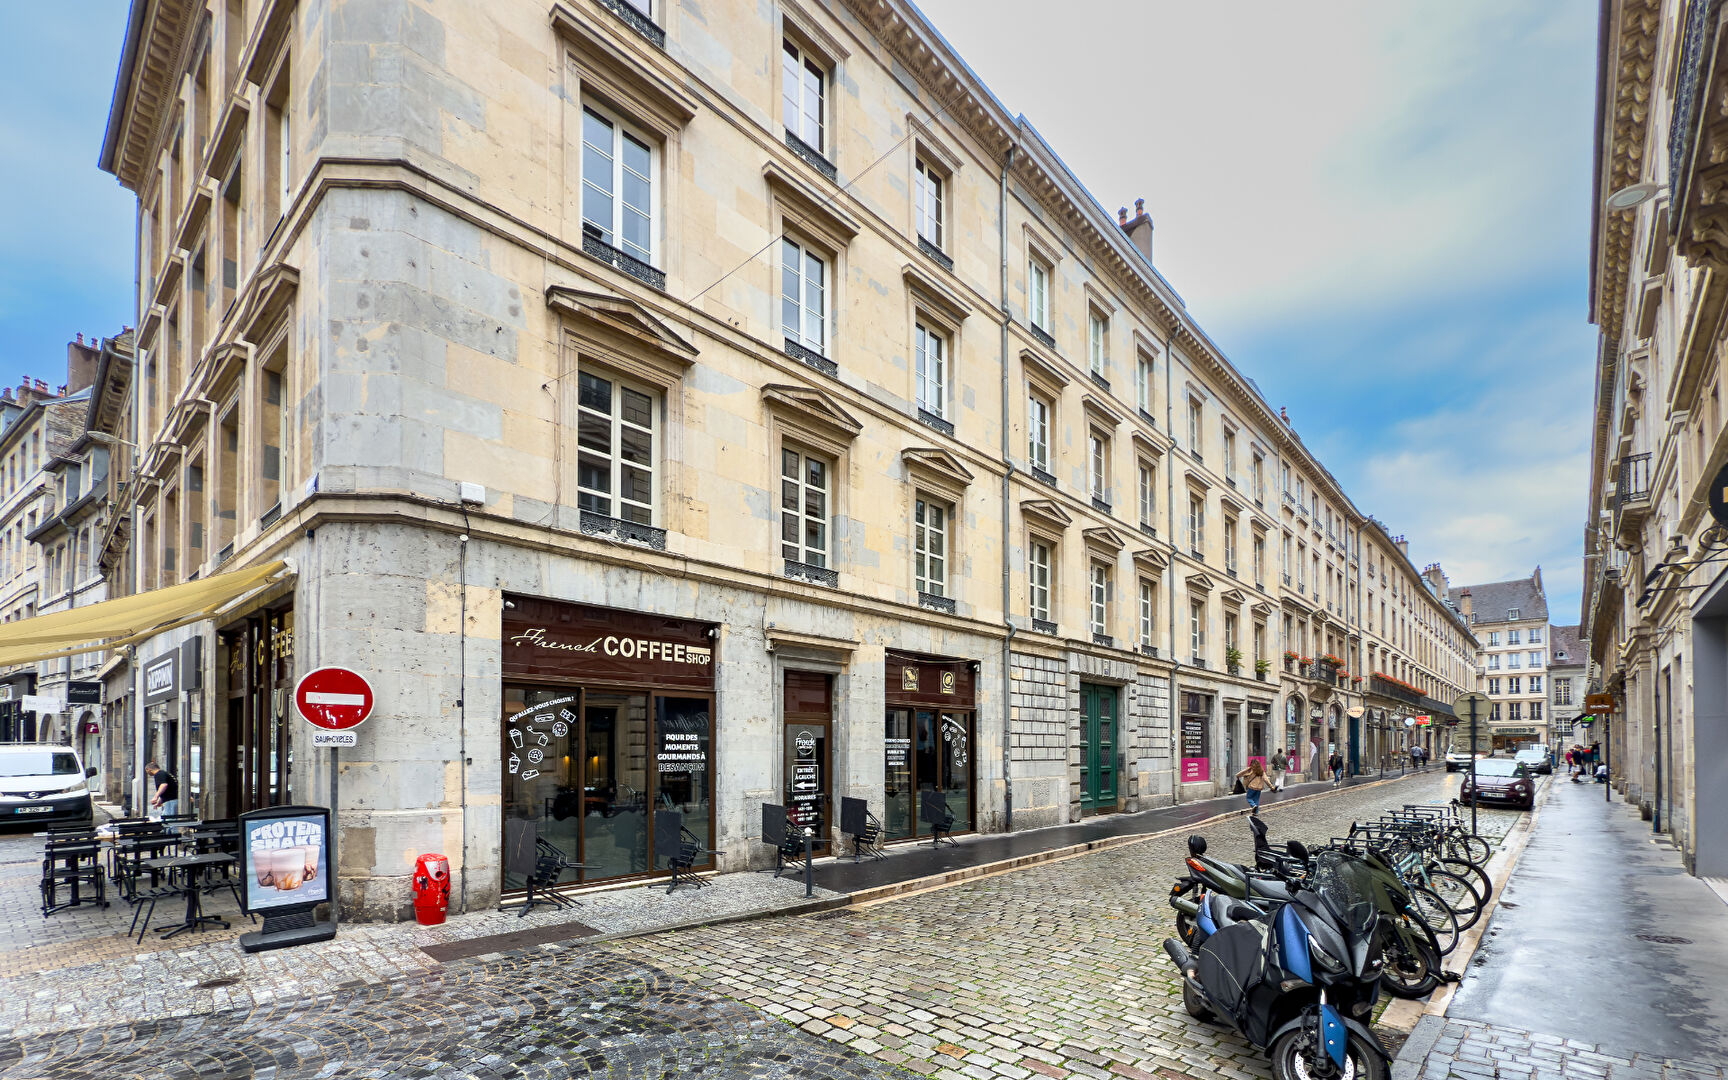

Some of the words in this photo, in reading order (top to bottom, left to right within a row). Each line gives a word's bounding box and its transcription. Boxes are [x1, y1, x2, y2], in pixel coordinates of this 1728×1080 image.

[510, 628, 602, 653] French
[603, 636, 685, 663] COFFEE
[686, 652, 711, 665] SHOP
[657, 753, 700, 761] GOURMANDS
[700, 751, 706, 760] À
[658, 763, 705, 774] BESANÇON
[250, 821, 321, 840] PROTEIN
[250, 834, 321, 851] SHAKE
